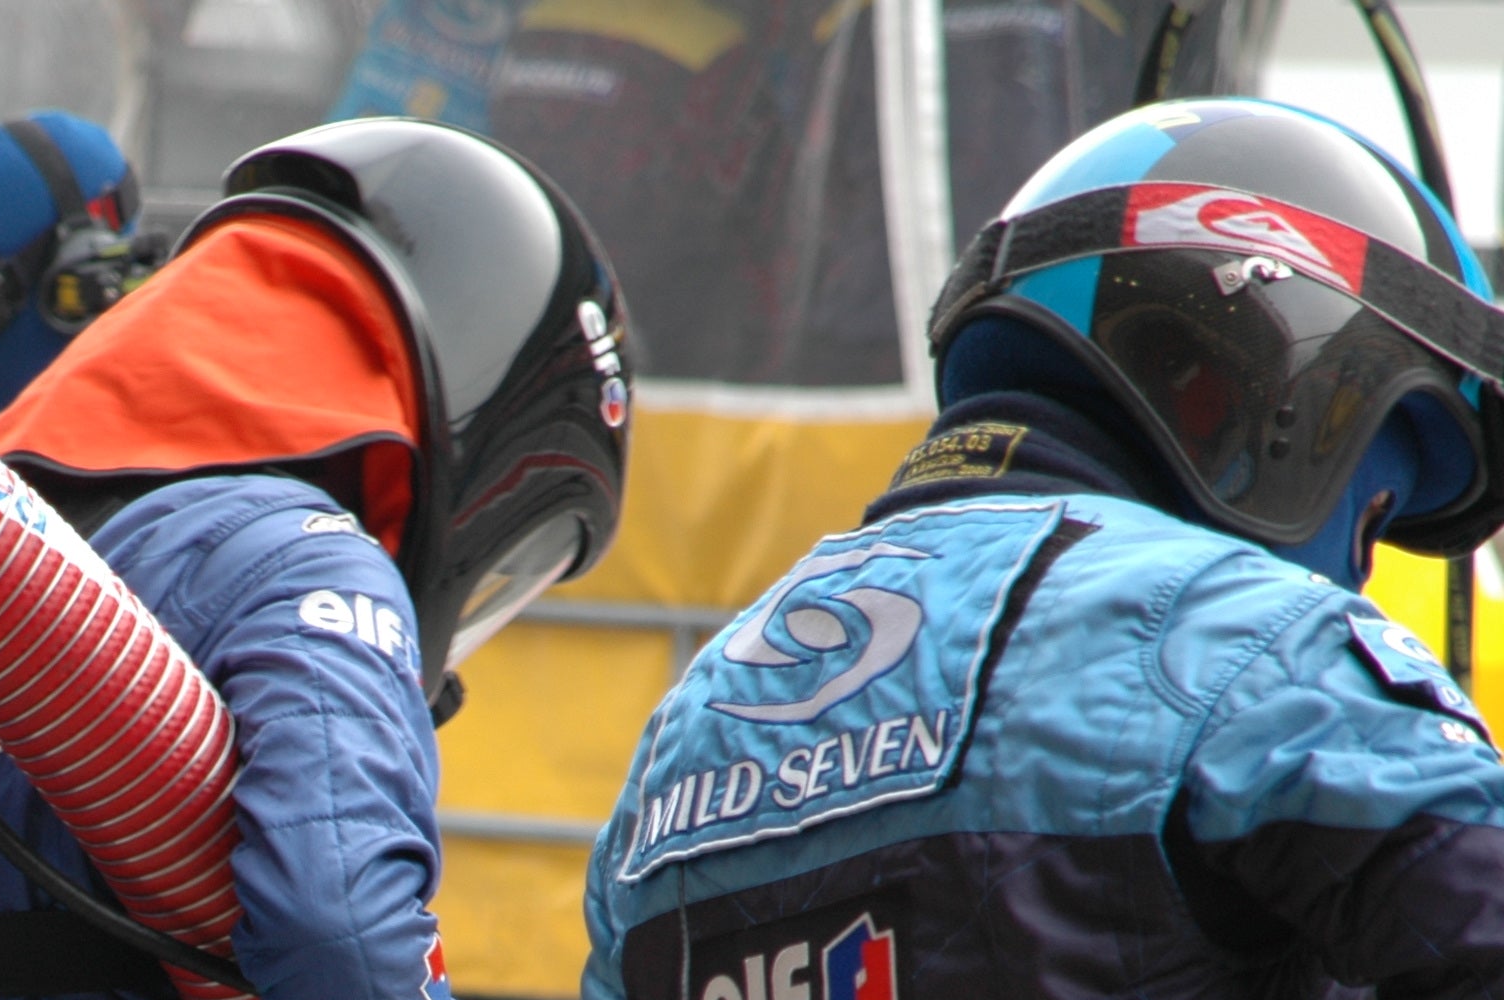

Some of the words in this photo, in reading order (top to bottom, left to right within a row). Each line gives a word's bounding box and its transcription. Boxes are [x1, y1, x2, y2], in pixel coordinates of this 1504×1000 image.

[298, 589, 403, 656] elf
[642, 760, 764, 853] MILD
[772, 710, 948, 809] SEVEN
